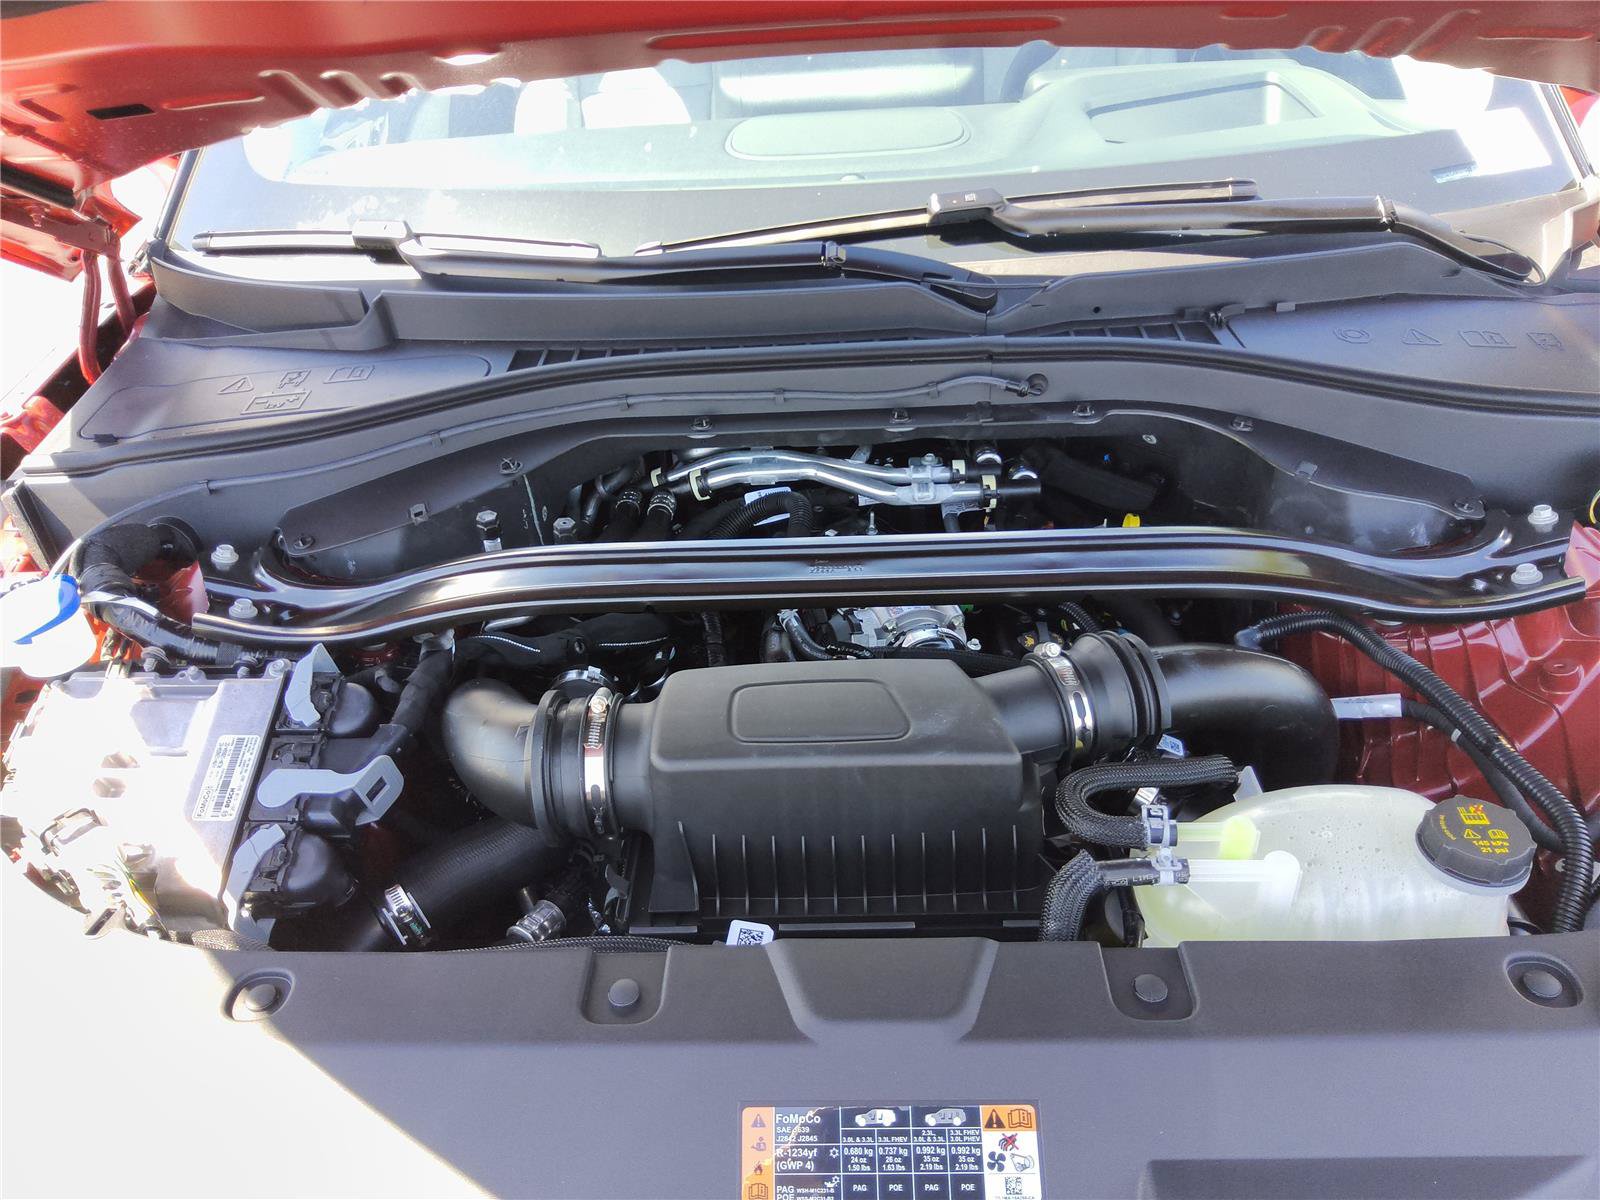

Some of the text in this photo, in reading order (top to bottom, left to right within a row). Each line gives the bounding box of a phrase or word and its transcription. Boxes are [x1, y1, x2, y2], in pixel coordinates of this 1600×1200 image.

[225, 787, 236, 808] BOSCH
[775, 1148, 818, 1159] R-1234yf
[843, 1147, 874, 1157] 0.680 kg
[878, 1147, 909, 1157] 0.737 kg
[915, 1146, 946, 1157] 0.992 kg
[950, 1146, 981, 1157] 0.992 kg
[776, 1161, 814, 1172] (GWP 4)
[776, 1186, 795, 1194] PAG
[852, 1184, 867, 1192] PAG
[888, 1184, 904, 1192] POE
